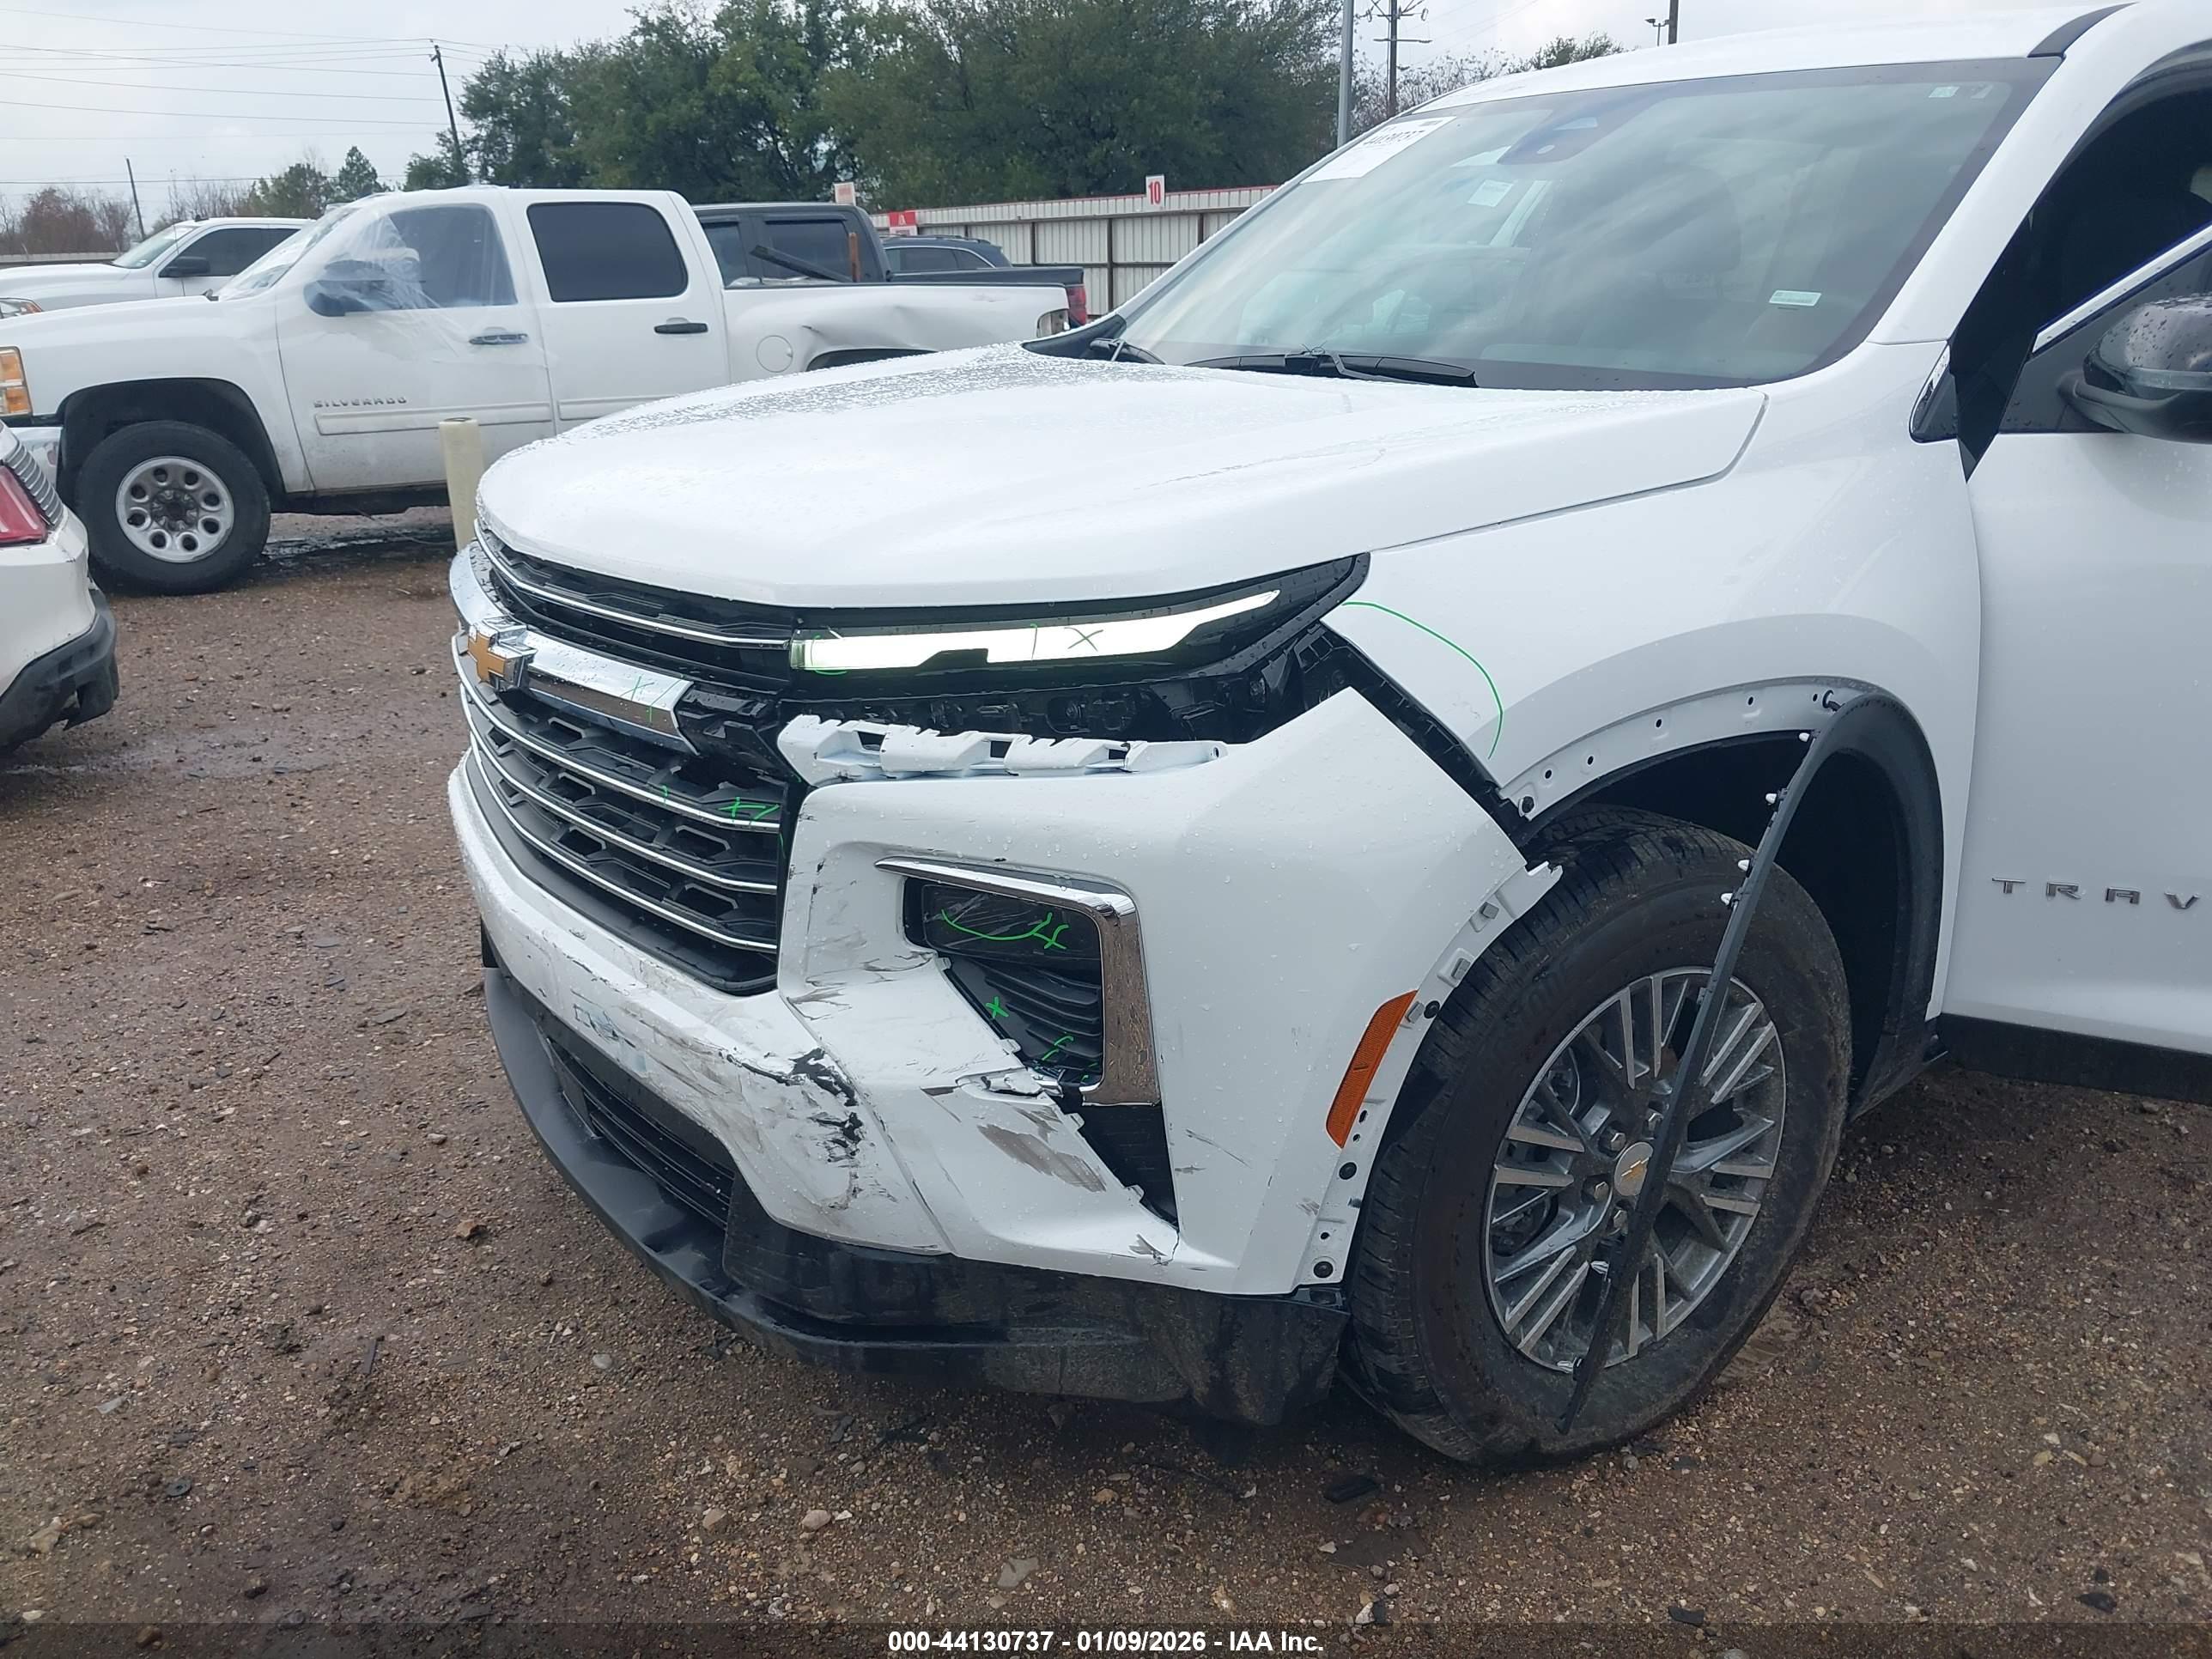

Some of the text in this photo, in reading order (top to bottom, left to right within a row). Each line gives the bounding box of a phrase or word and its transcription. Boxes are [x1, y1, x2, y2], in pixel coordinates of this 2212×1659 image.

[1148, 180, 1162, 205] 10
[313, 397, 408, 408] SILVERADO
[1991, 877, 2201, 910] TRAV
